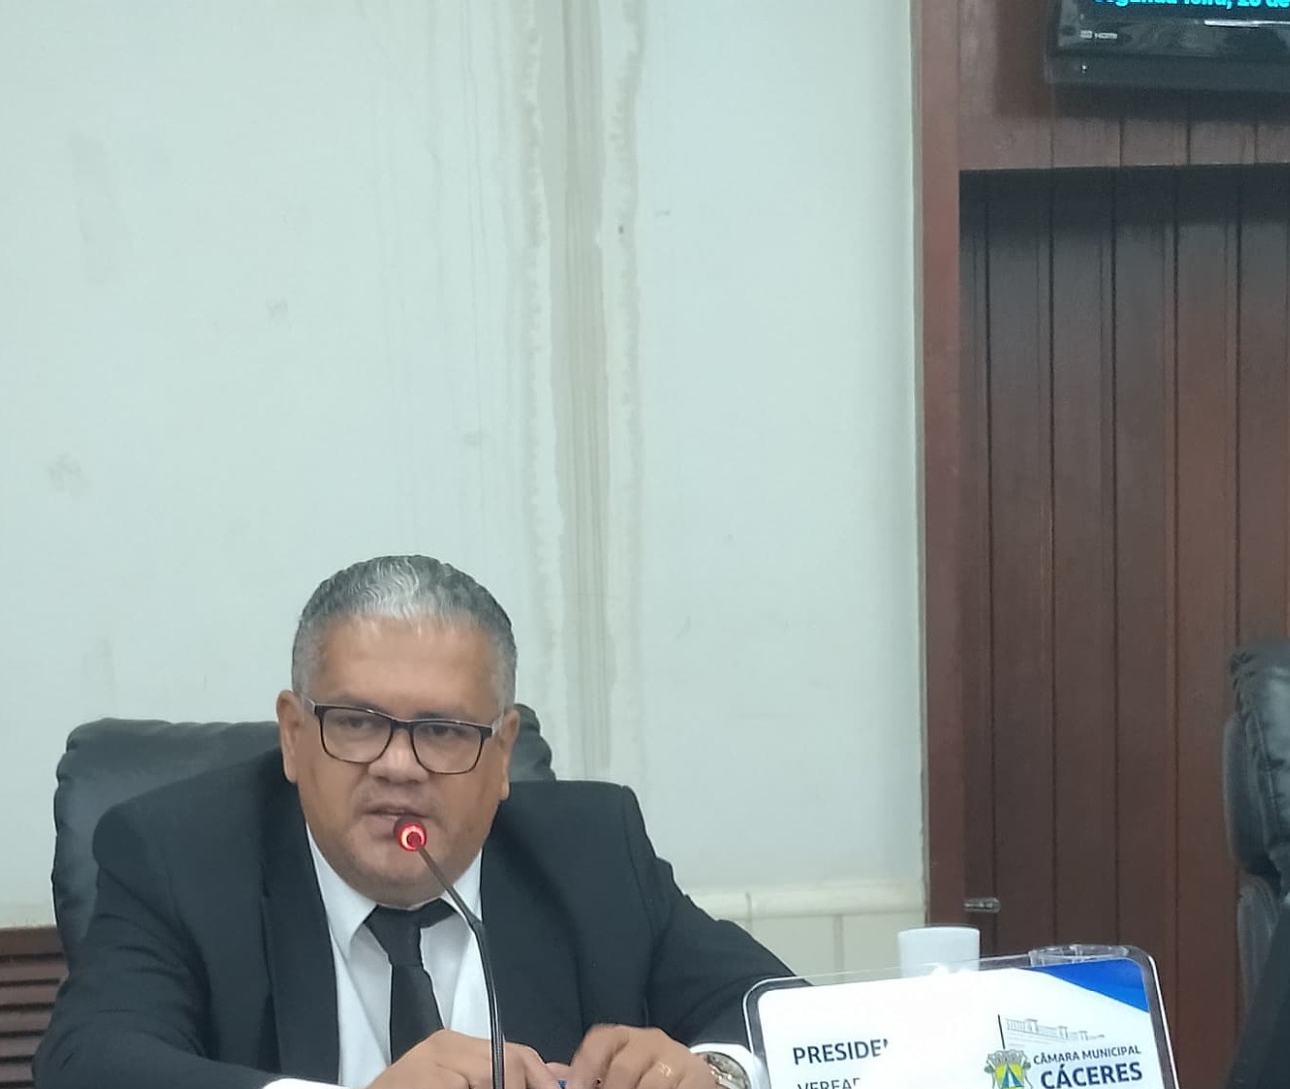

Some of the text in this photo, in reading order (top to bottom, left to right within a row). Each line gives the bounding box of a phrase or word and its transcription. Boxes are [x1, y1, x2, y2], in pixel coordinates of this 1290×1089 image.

[1033, 1044, 1143, 1065] CÂMARA MUNICIPAL
[1040, 1061, 1144, 1089] CÁCERES
